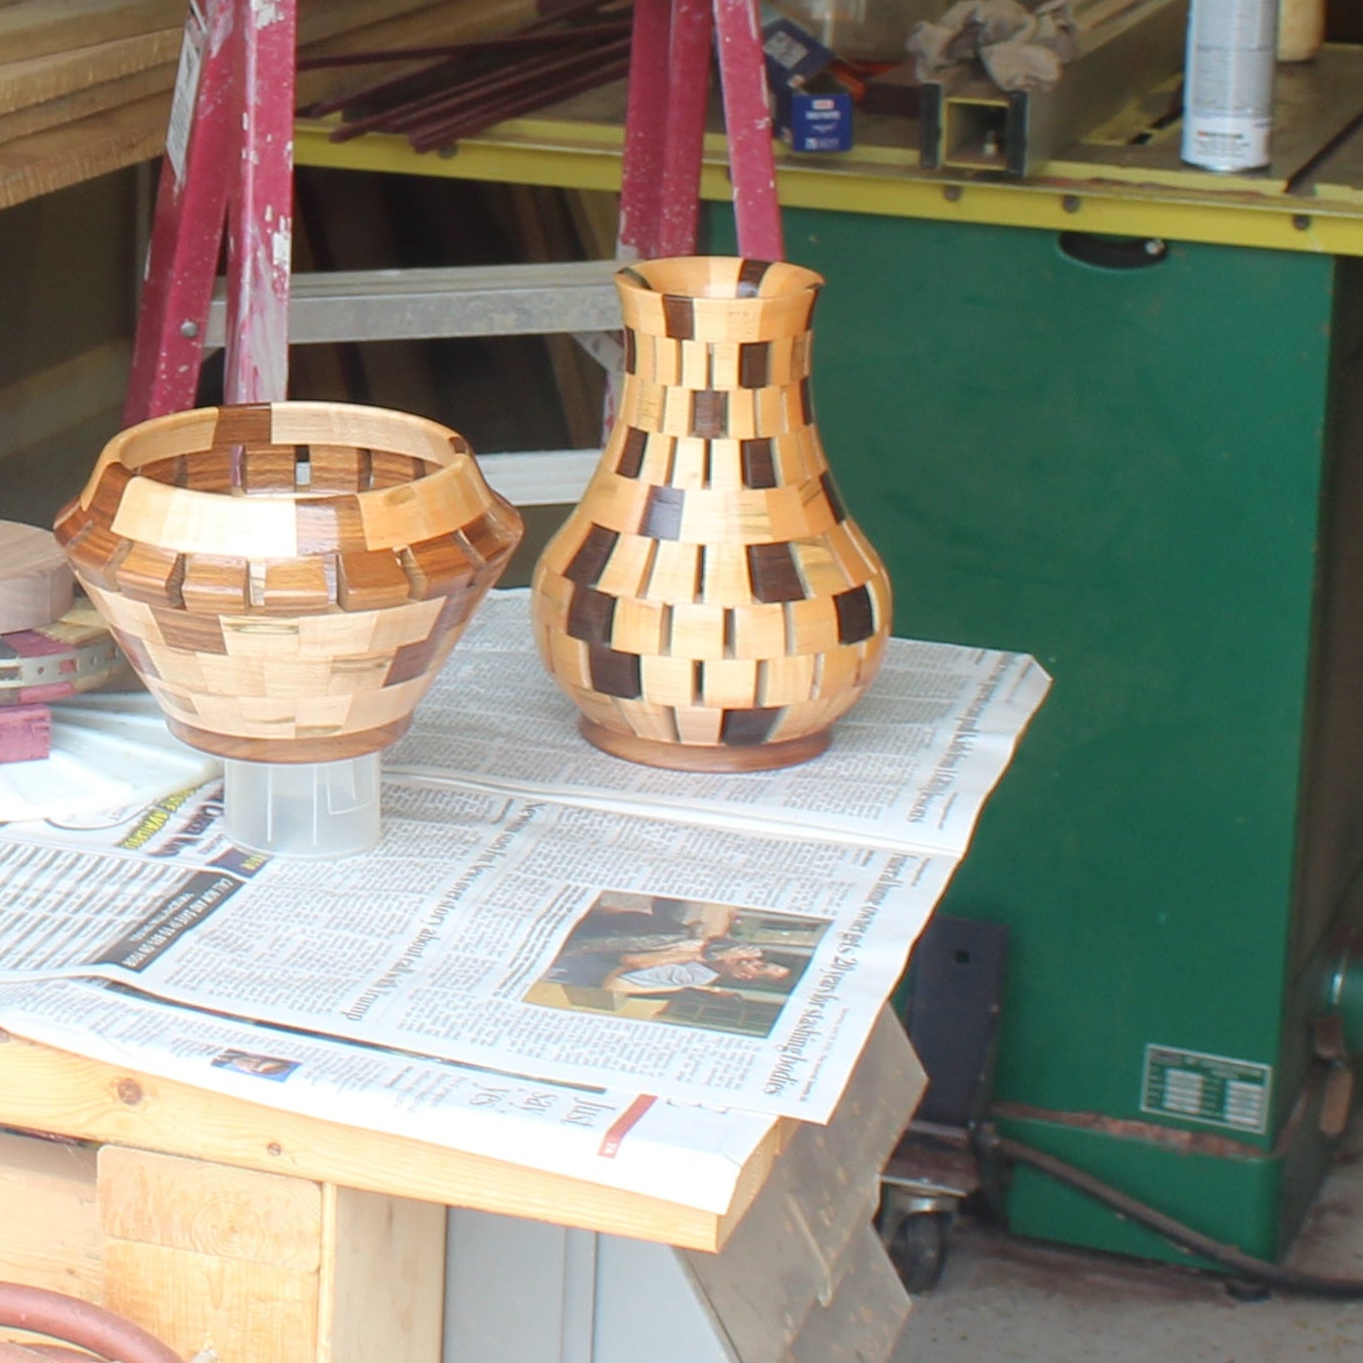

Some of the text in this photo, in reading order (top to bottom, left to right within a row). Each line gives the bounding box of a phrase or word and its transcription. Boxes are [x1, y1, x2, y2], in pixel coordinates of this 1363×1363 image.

[828, 955, 860, 971] 20
[815, 969, 844, 993] years
[806, 992, 843, 1007] for
[775, 1008, 822, 1055] stashing
[761, 1054, 809, 1095] bodies
[565, 1094, 617, 1129] Just
